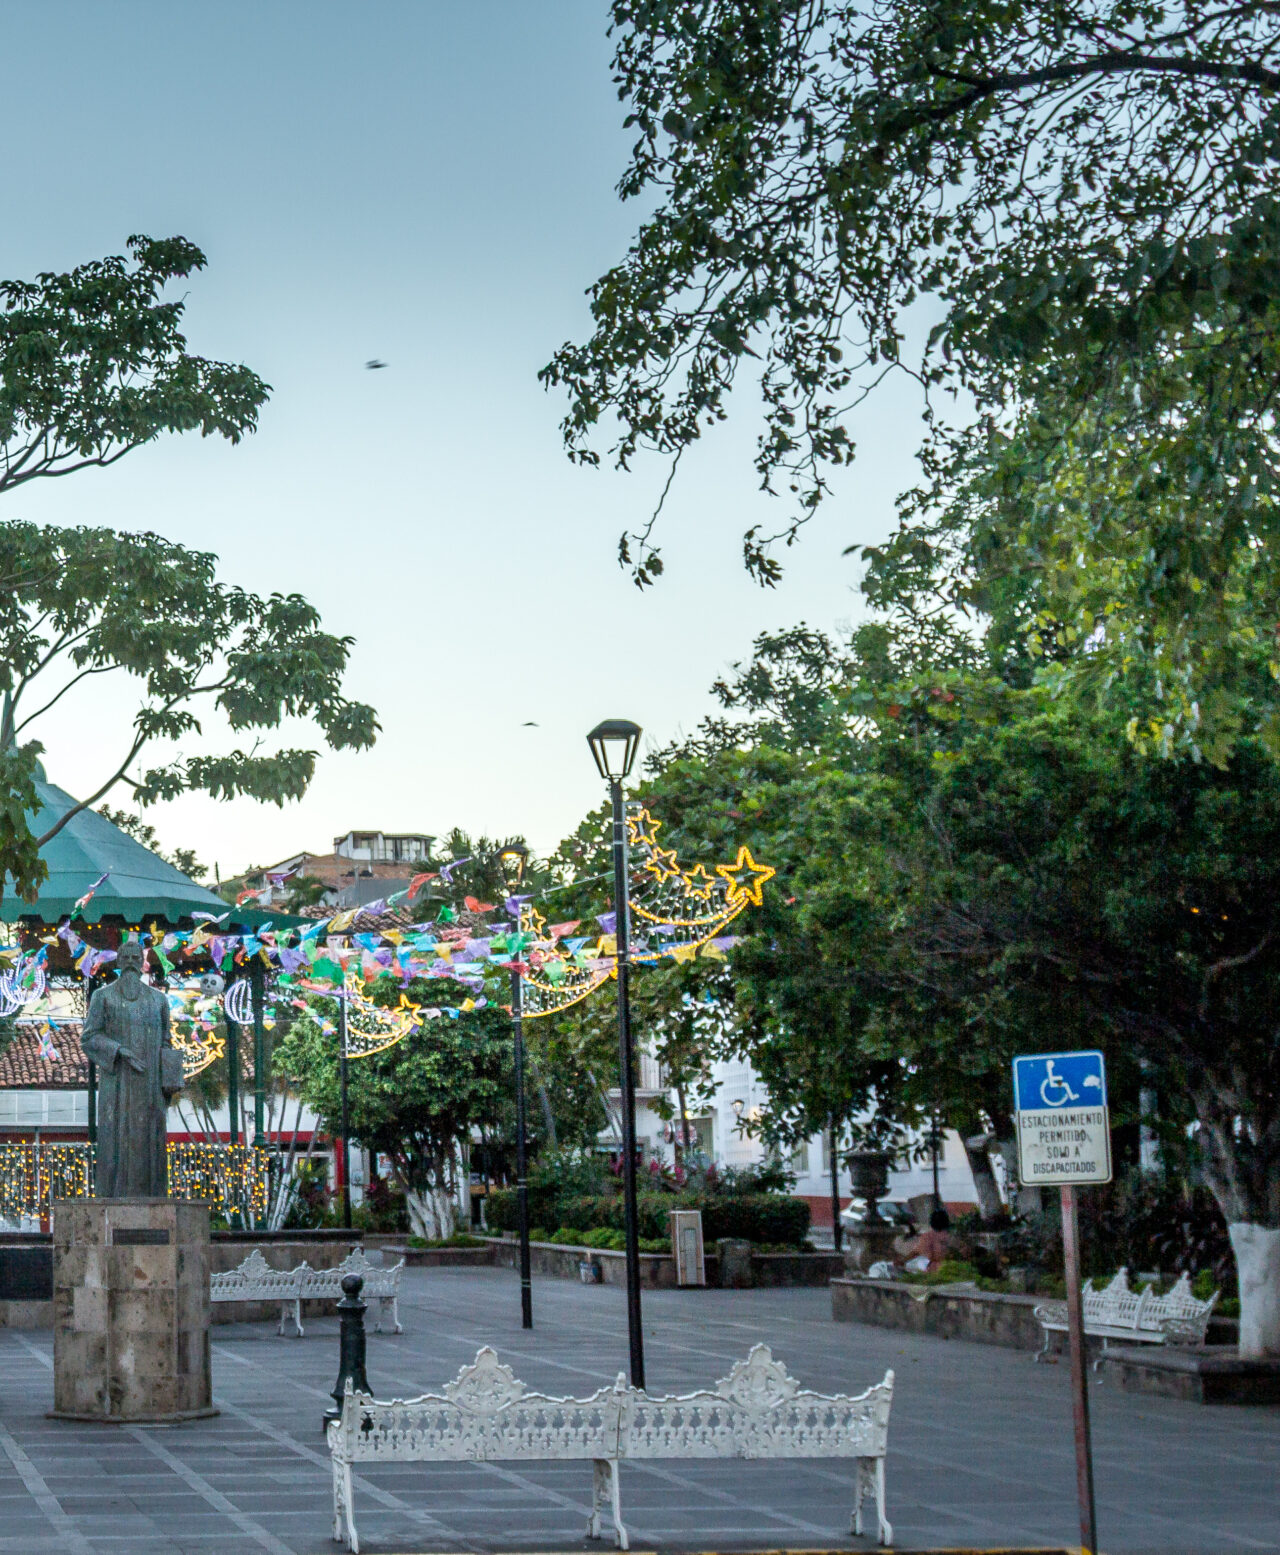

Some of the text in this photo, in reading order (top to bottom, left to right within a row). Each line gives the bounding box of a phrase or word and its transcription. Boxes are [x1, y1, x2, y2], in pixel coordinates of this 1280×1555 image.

[1022, 1112, 1103, 1129] ESTACIONAMIENTO
[1039, 1129, 1087, 1144] PERMITIDO
[1046, 1146, 1081, 1159] SOLO A
[1033, 1161, 1097, 1175] DISCAPACITADOS
